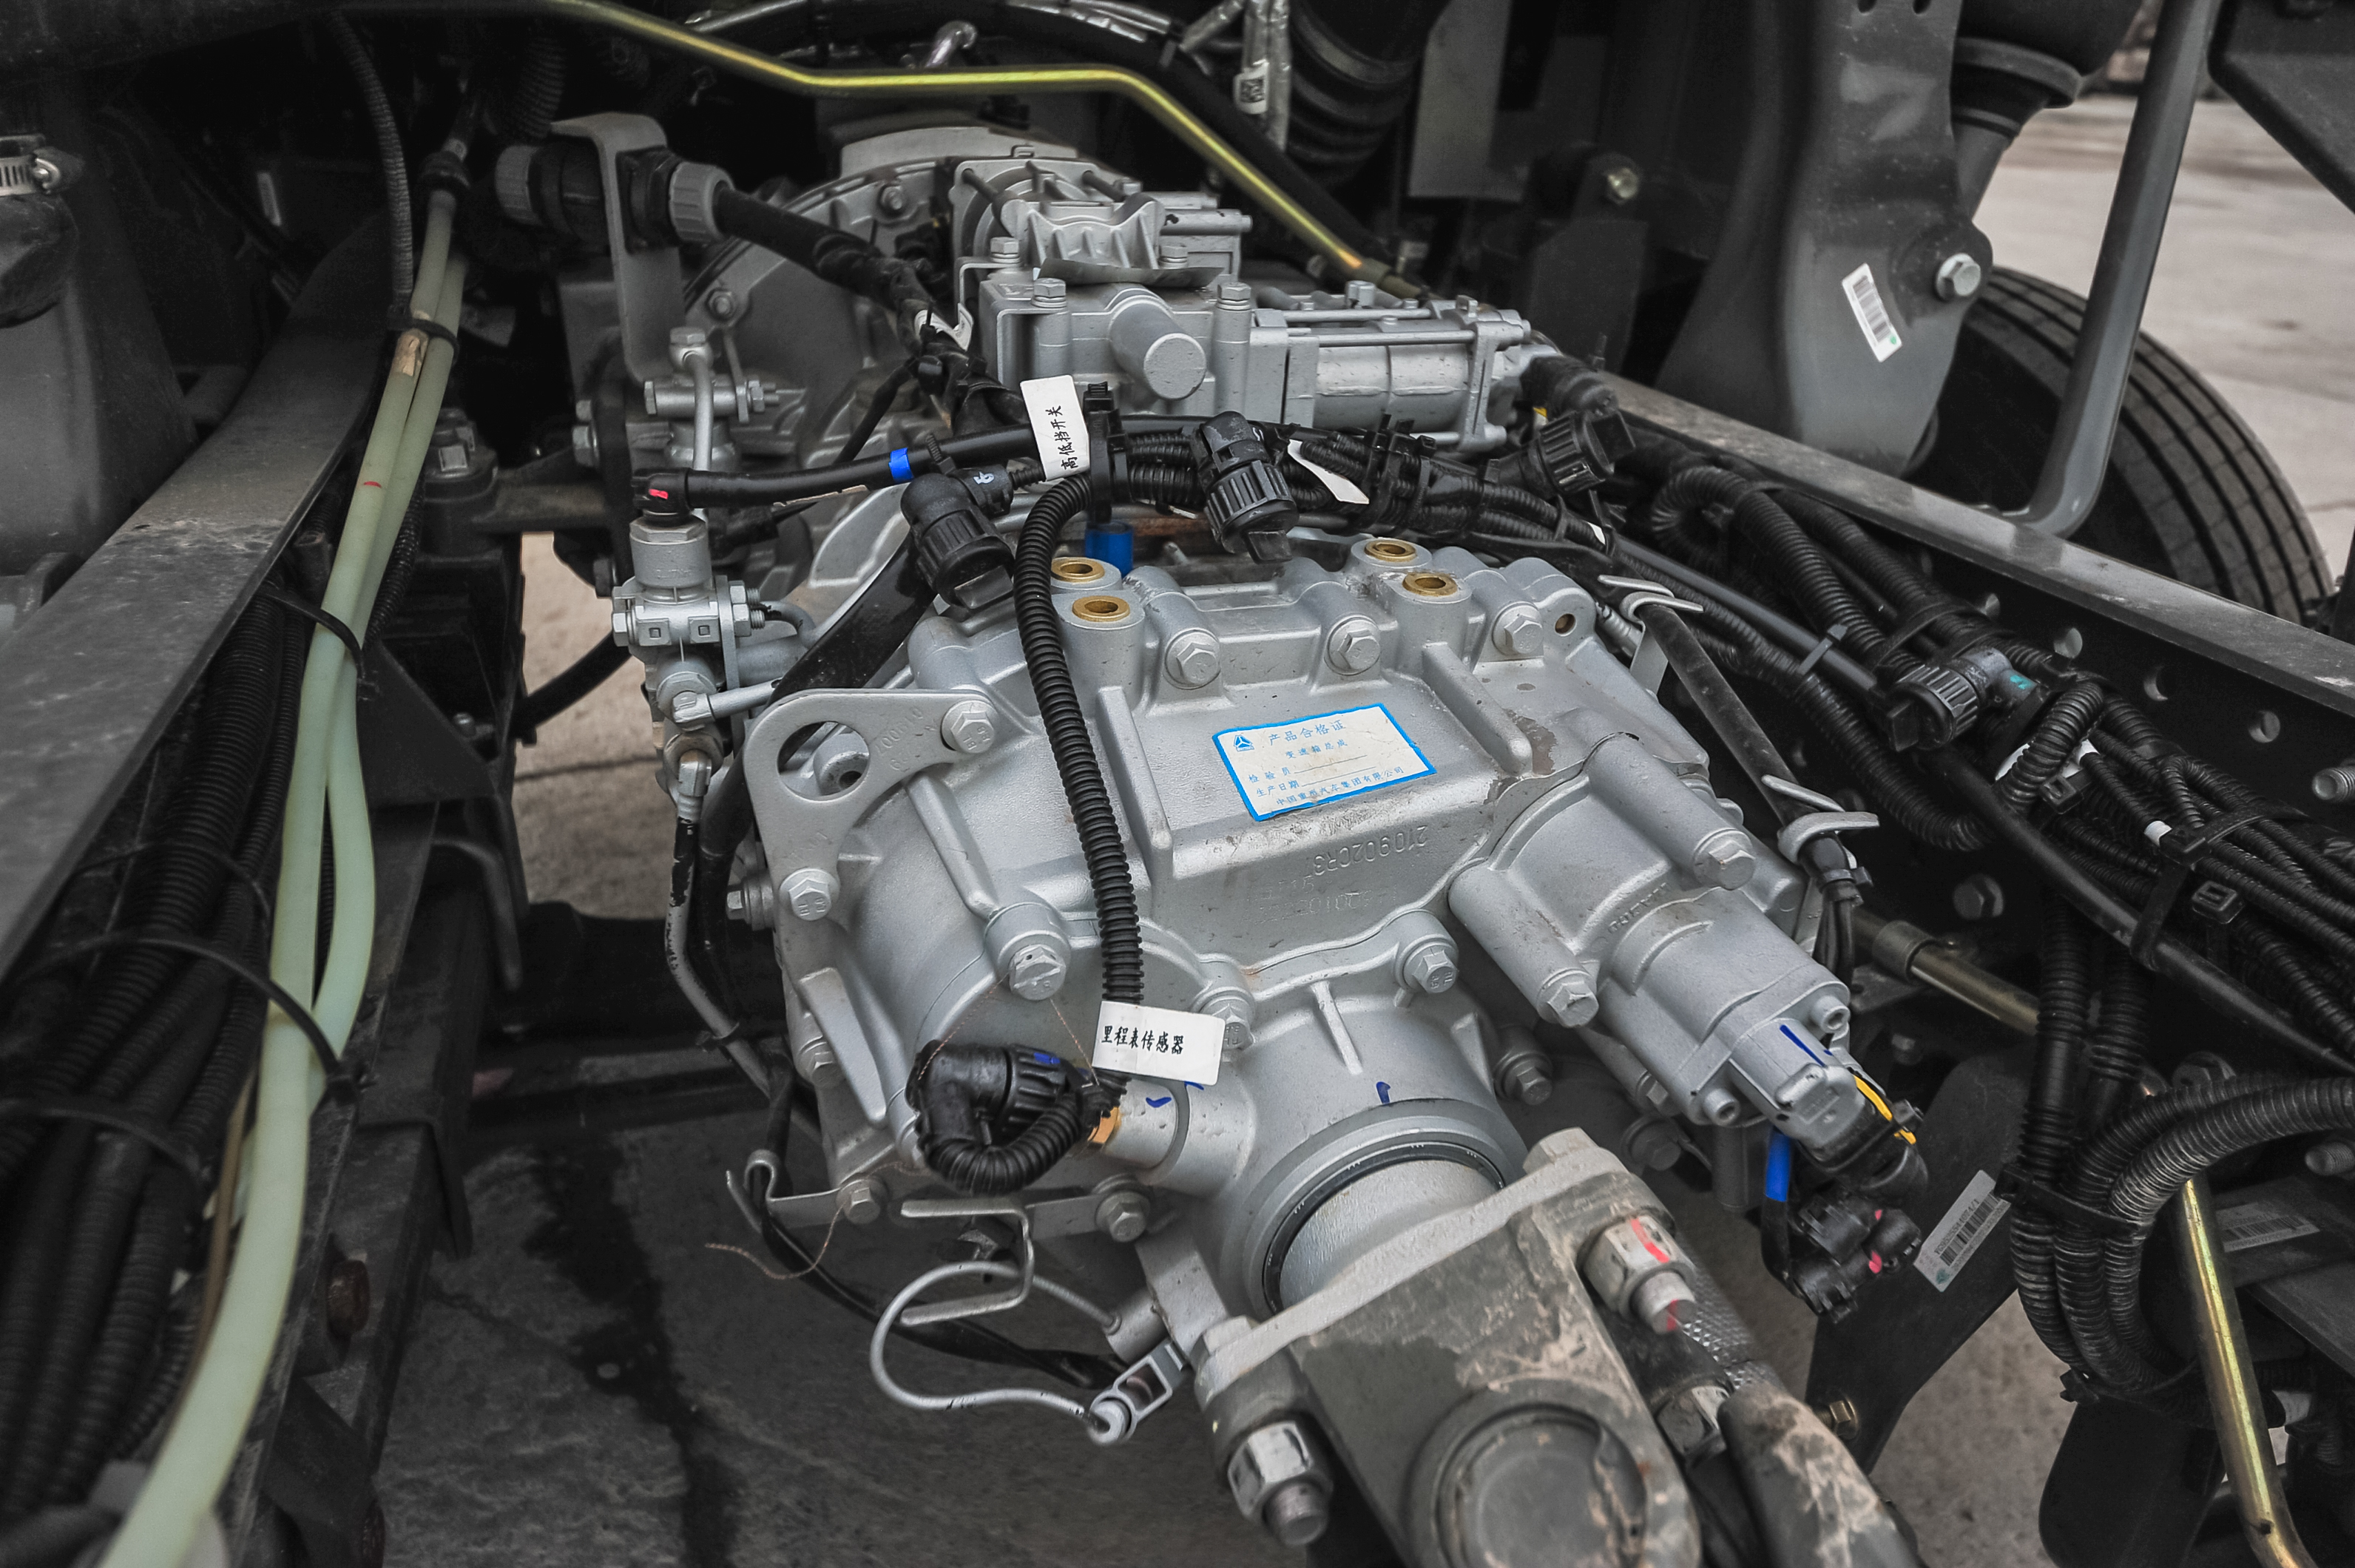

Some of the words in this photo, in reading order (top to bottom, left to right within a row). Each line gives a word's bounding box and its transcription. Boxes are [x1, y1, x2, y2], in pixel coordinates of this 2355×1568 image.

[1045, 405, 1078, 470] 高低挡开关
[1268, 720, 1346, 746] 产品合格证
[1285, 739, 1348, 759] 变速箱总成
[1249, 767, 1291, 783] 检验员
[1257, 780, 1300, 797] 生产日期
[1101, 1025, 1184, 1055] 里程表传感器
